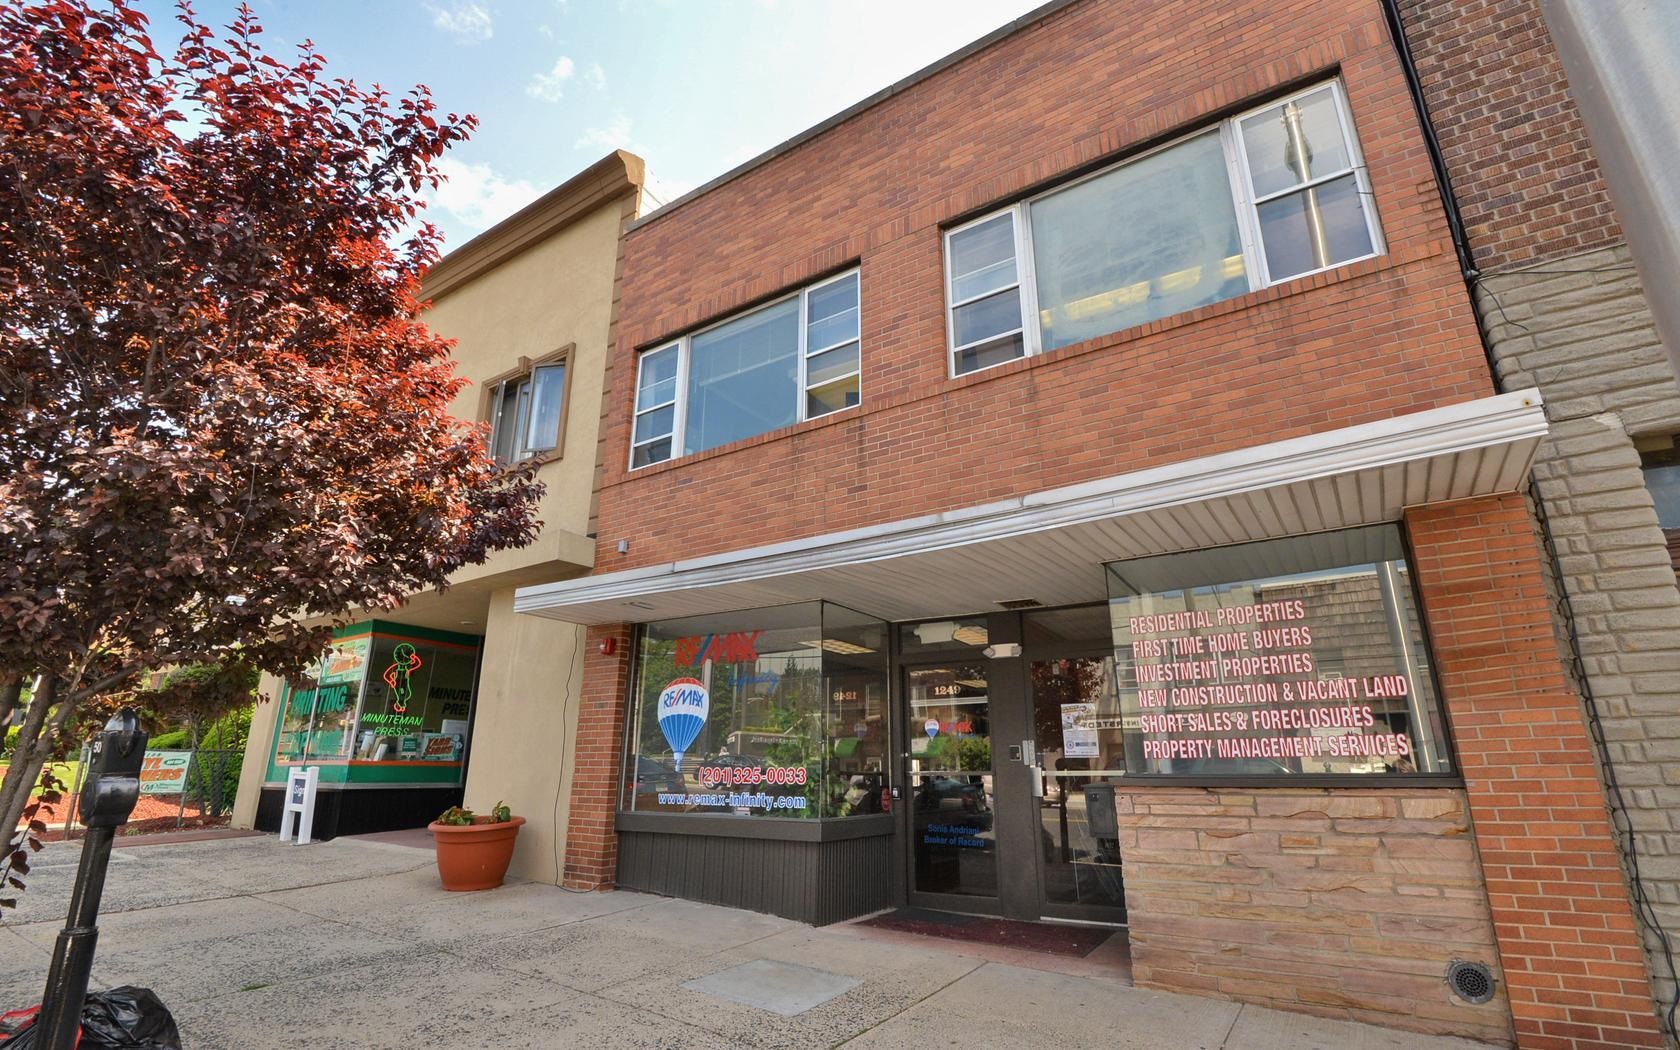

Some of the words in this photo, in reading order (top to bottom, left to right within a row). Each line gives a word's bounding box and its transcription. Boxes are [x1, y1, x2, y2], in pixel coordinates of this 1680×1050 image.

[1130, 610, 1214, 635] RESIDENTIAL
[1216, 600, 1305, 627] PROPERTIES
[1132, 639, 1169, 659] FIRST
[1171, 635, 1205, 656] TIME
[1207, 631, 1250, 653] HOME
[1252, 626, 1312, 649] BUYERS
[1135, 660, 1218, 683] INVESTMENT
[1222, 652, 1313, 678] PROPERTIES
[289, 686, 347, 716] PRINTING
[428, 686, 473, 703] MINUTE
[663, 688, 705, 709] RE/MAX
[934, 685, 961, 696] 1249
[1137, 688, 1169, 708] NEW
[1171, 682, 1278, 706] CONSTRUCTION
[1282, 681, 1295, 702] &
[1296, 677, 1358, 701] VACANT
[1362, 675, 1409, 698] LAND
[361, 713, 423, 727] MINUTEMAN
[1141, 713, 1184, 734] SHORT
[1187, 711, 1232, 732] SALES
[1236, 710, 1248, 731] &
[1251, 705, 1374, 730] FORECLOSURES
[374, 726, 409, 737] PRESS
[1143, 739, 1213, 759] PROPERTY
[1216, 736, 1323, 759] MANAGEMENT
[1327, 733, 1410, 757] SERVICES
[698, 766, 808, 787] (201)325-0033
[657, 791, 808, 812] www.remax-infinity.com
